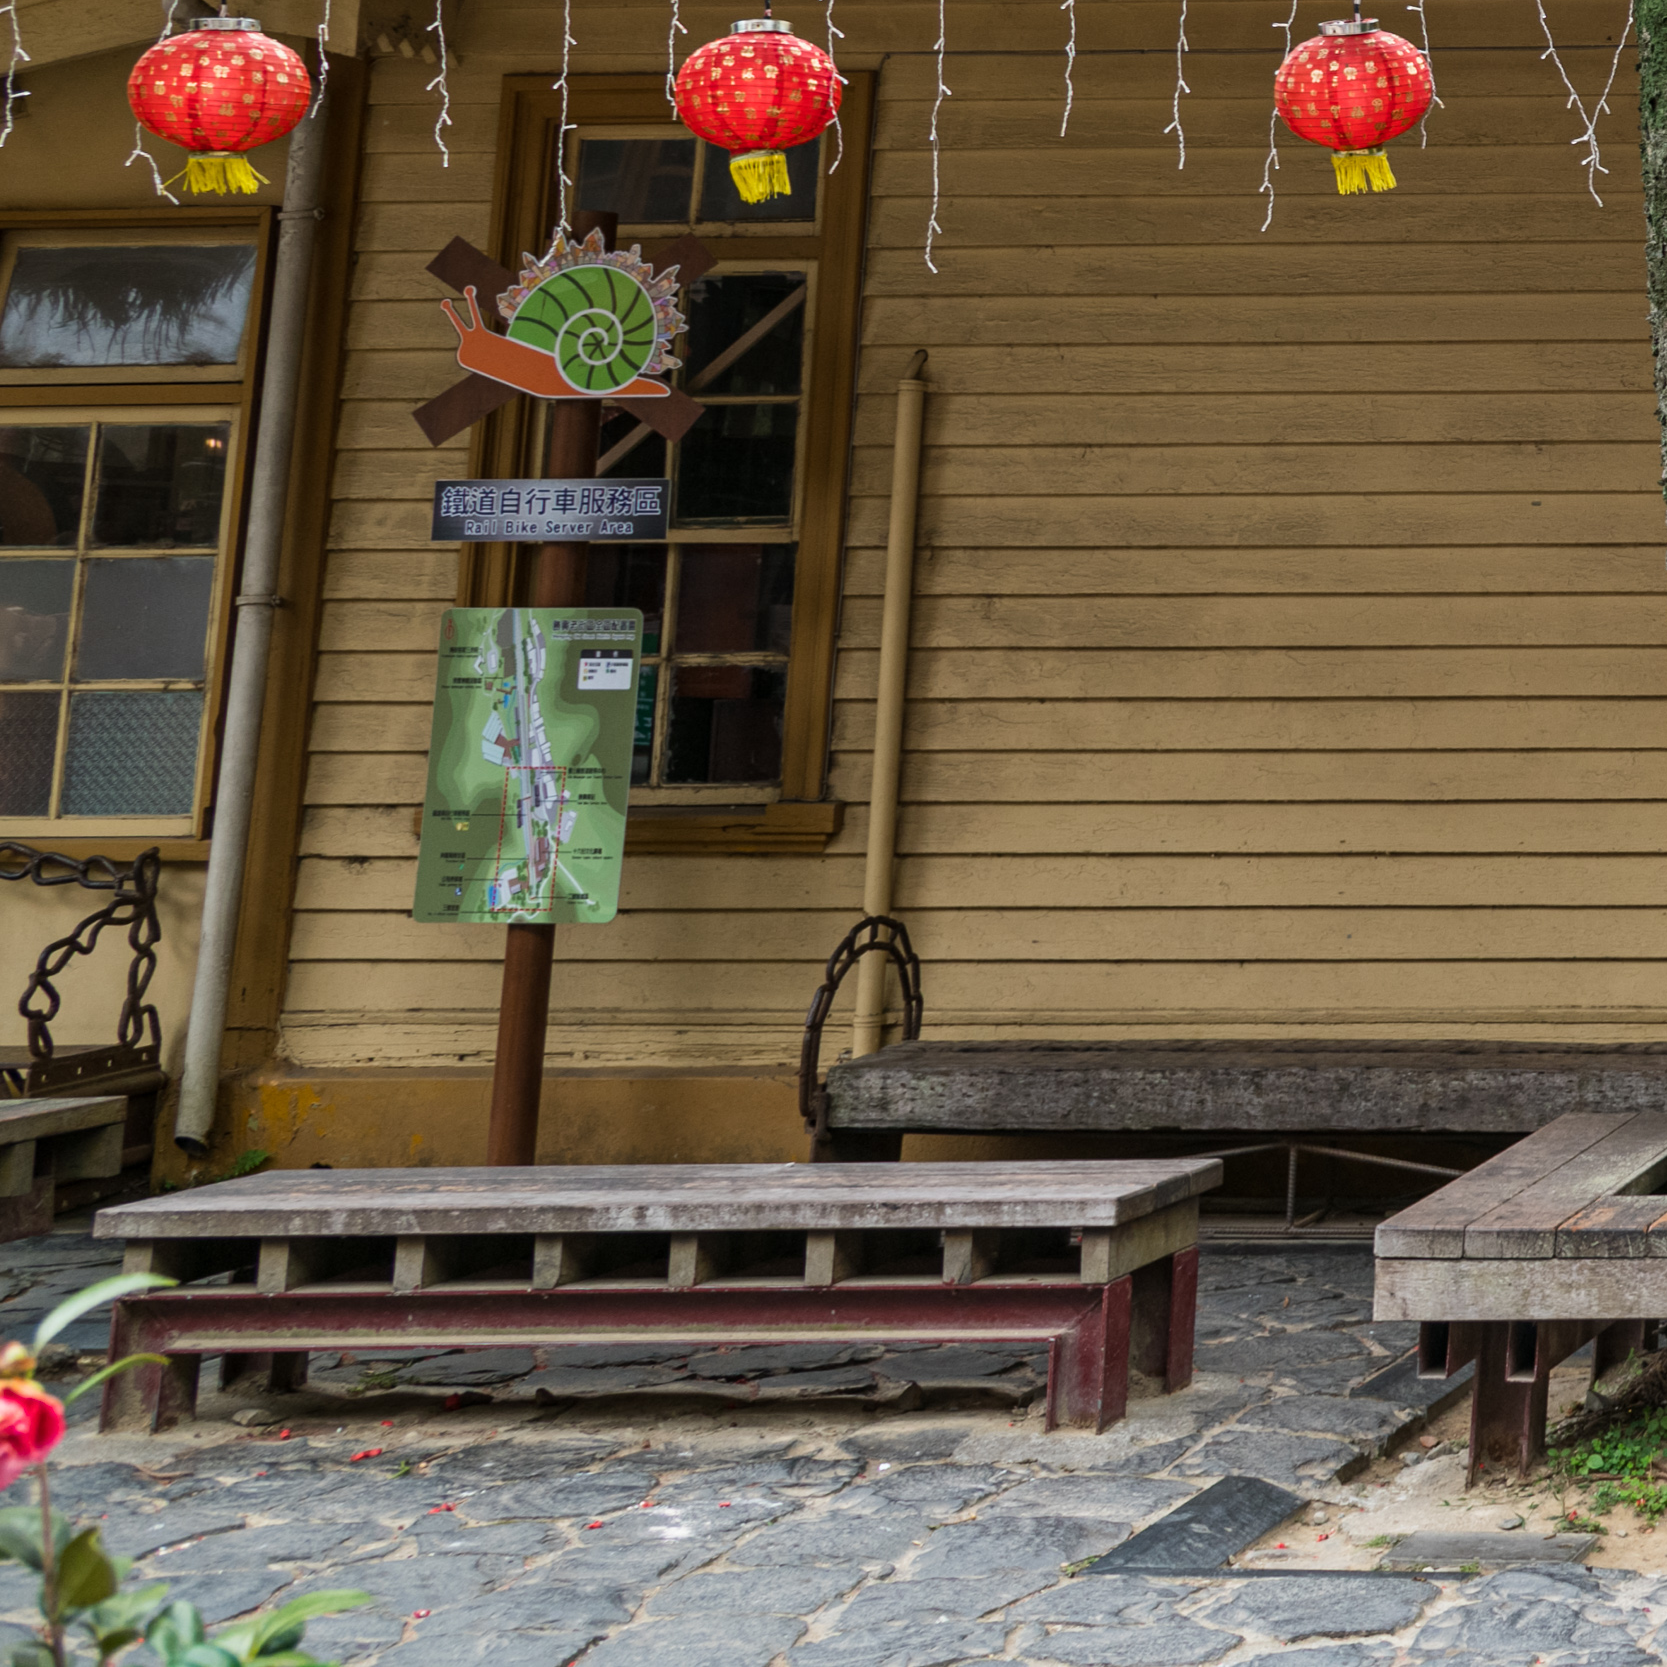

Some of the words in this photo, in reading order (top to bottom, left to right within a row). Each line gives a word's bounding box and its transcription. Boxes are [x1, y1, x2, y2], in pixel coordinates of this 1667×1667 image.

[441, 486, 663, 516] 鐵道自行車服務區
[465, 520, 498, 535] Rail
[505, 520, 538, 535] Bike
[545, 520, 593, 535] Server
[600, 519, 634, 534] Area
